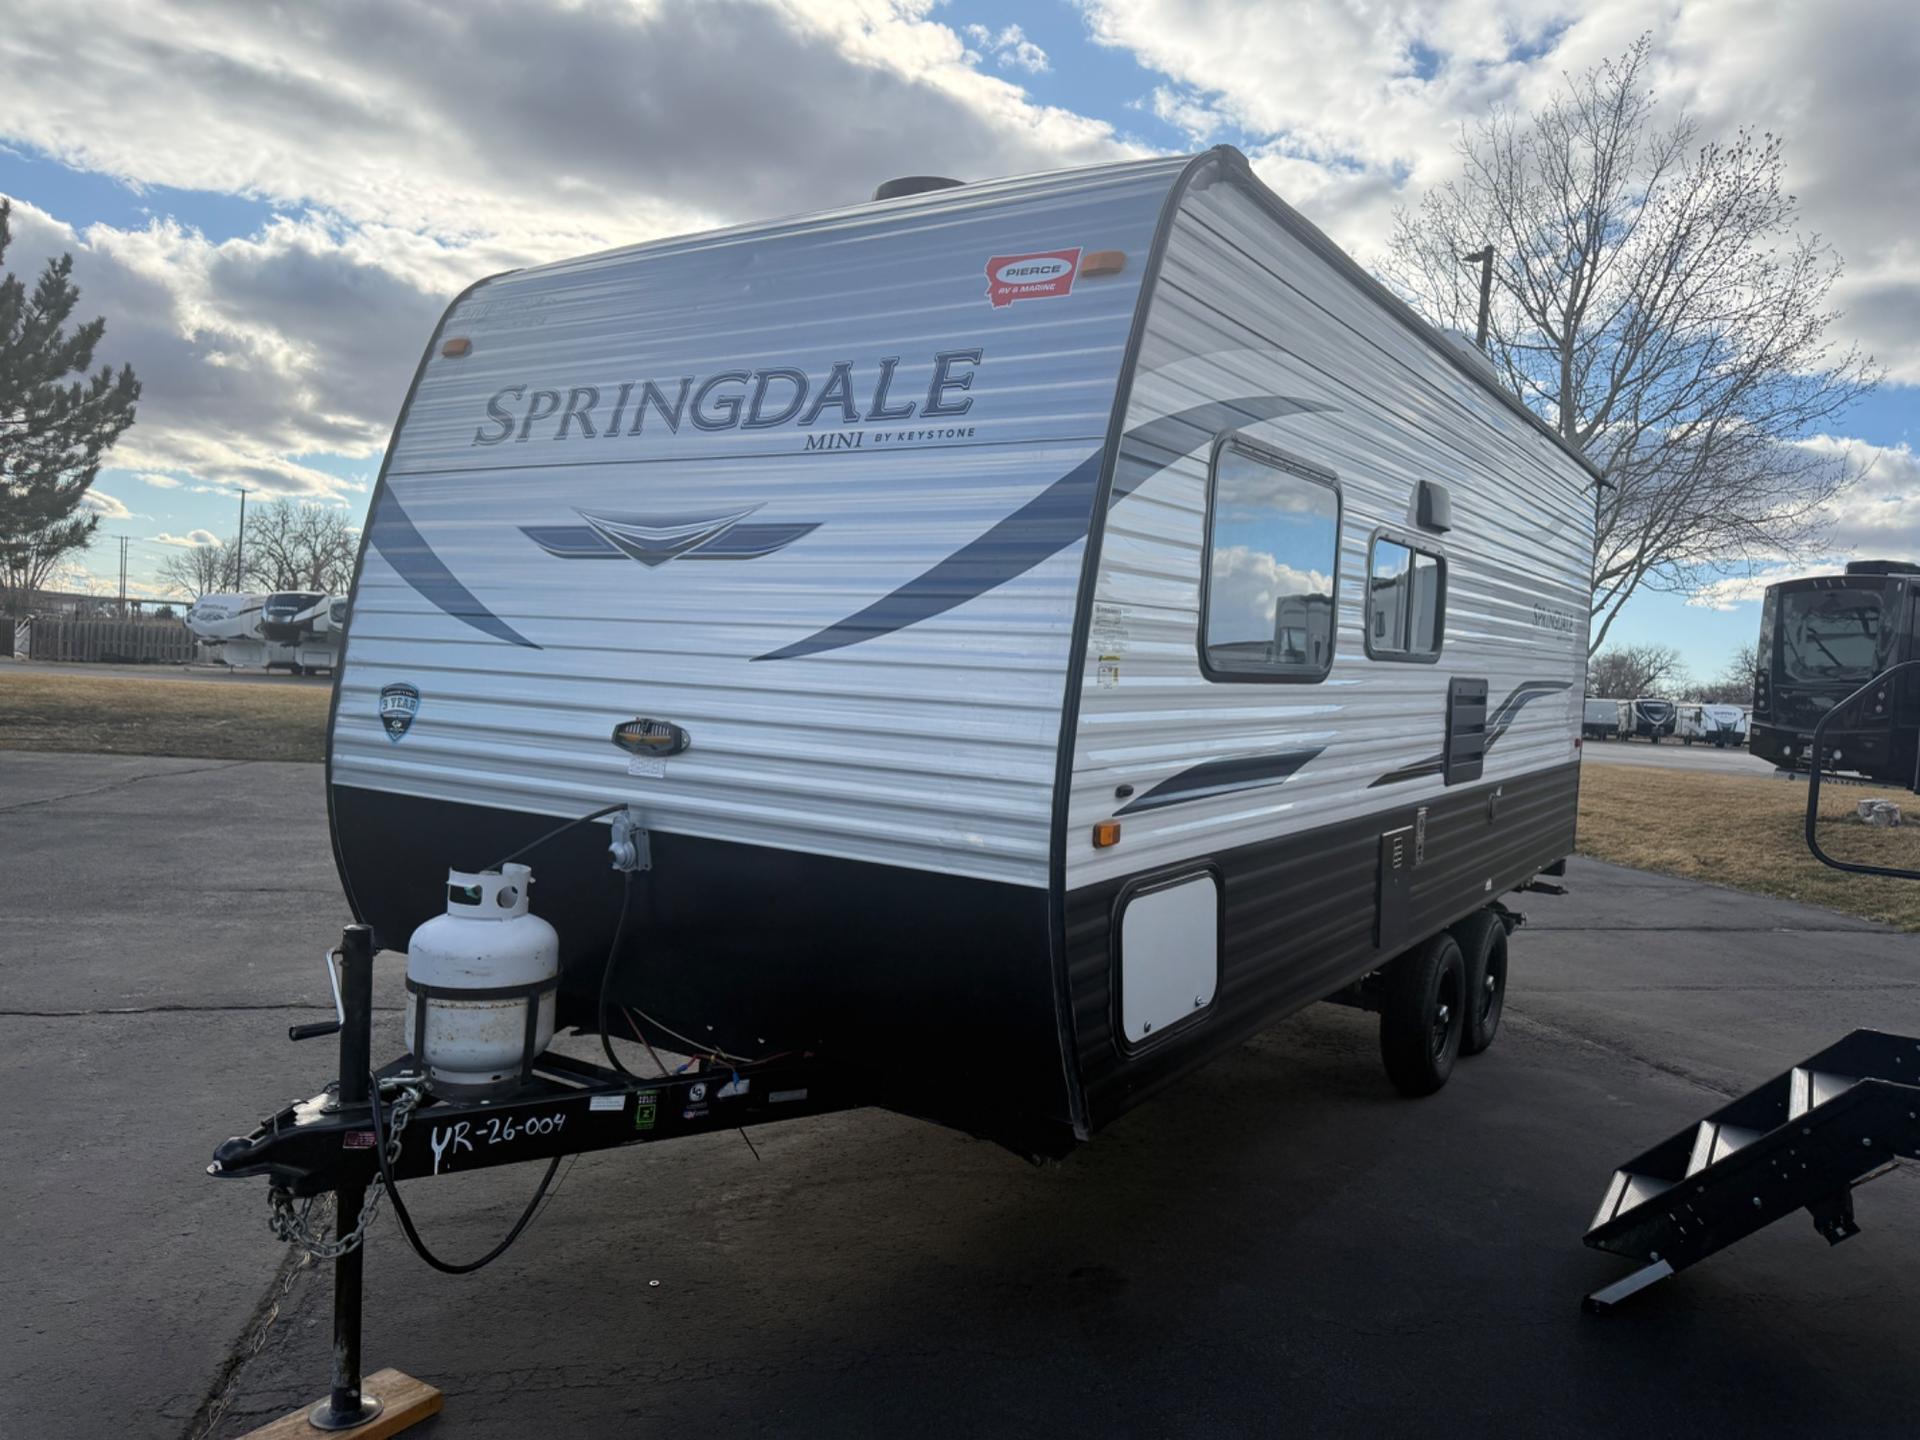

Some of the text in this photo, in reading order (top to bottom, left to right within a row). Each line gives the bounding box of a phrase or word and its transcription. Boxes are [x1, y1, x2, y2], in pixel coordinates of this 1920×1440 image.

[1005, 264, 1061, 276] PIERCE
[998, 287, 1012, 295] RV
[1019, 283, 1056, 293] MARINE
[470, 347, 984, 446] SPRINGDALE
[804, 427, 976, 451] MINI BY KEYSTONE
[390, 697, 417, 711] YEAR
